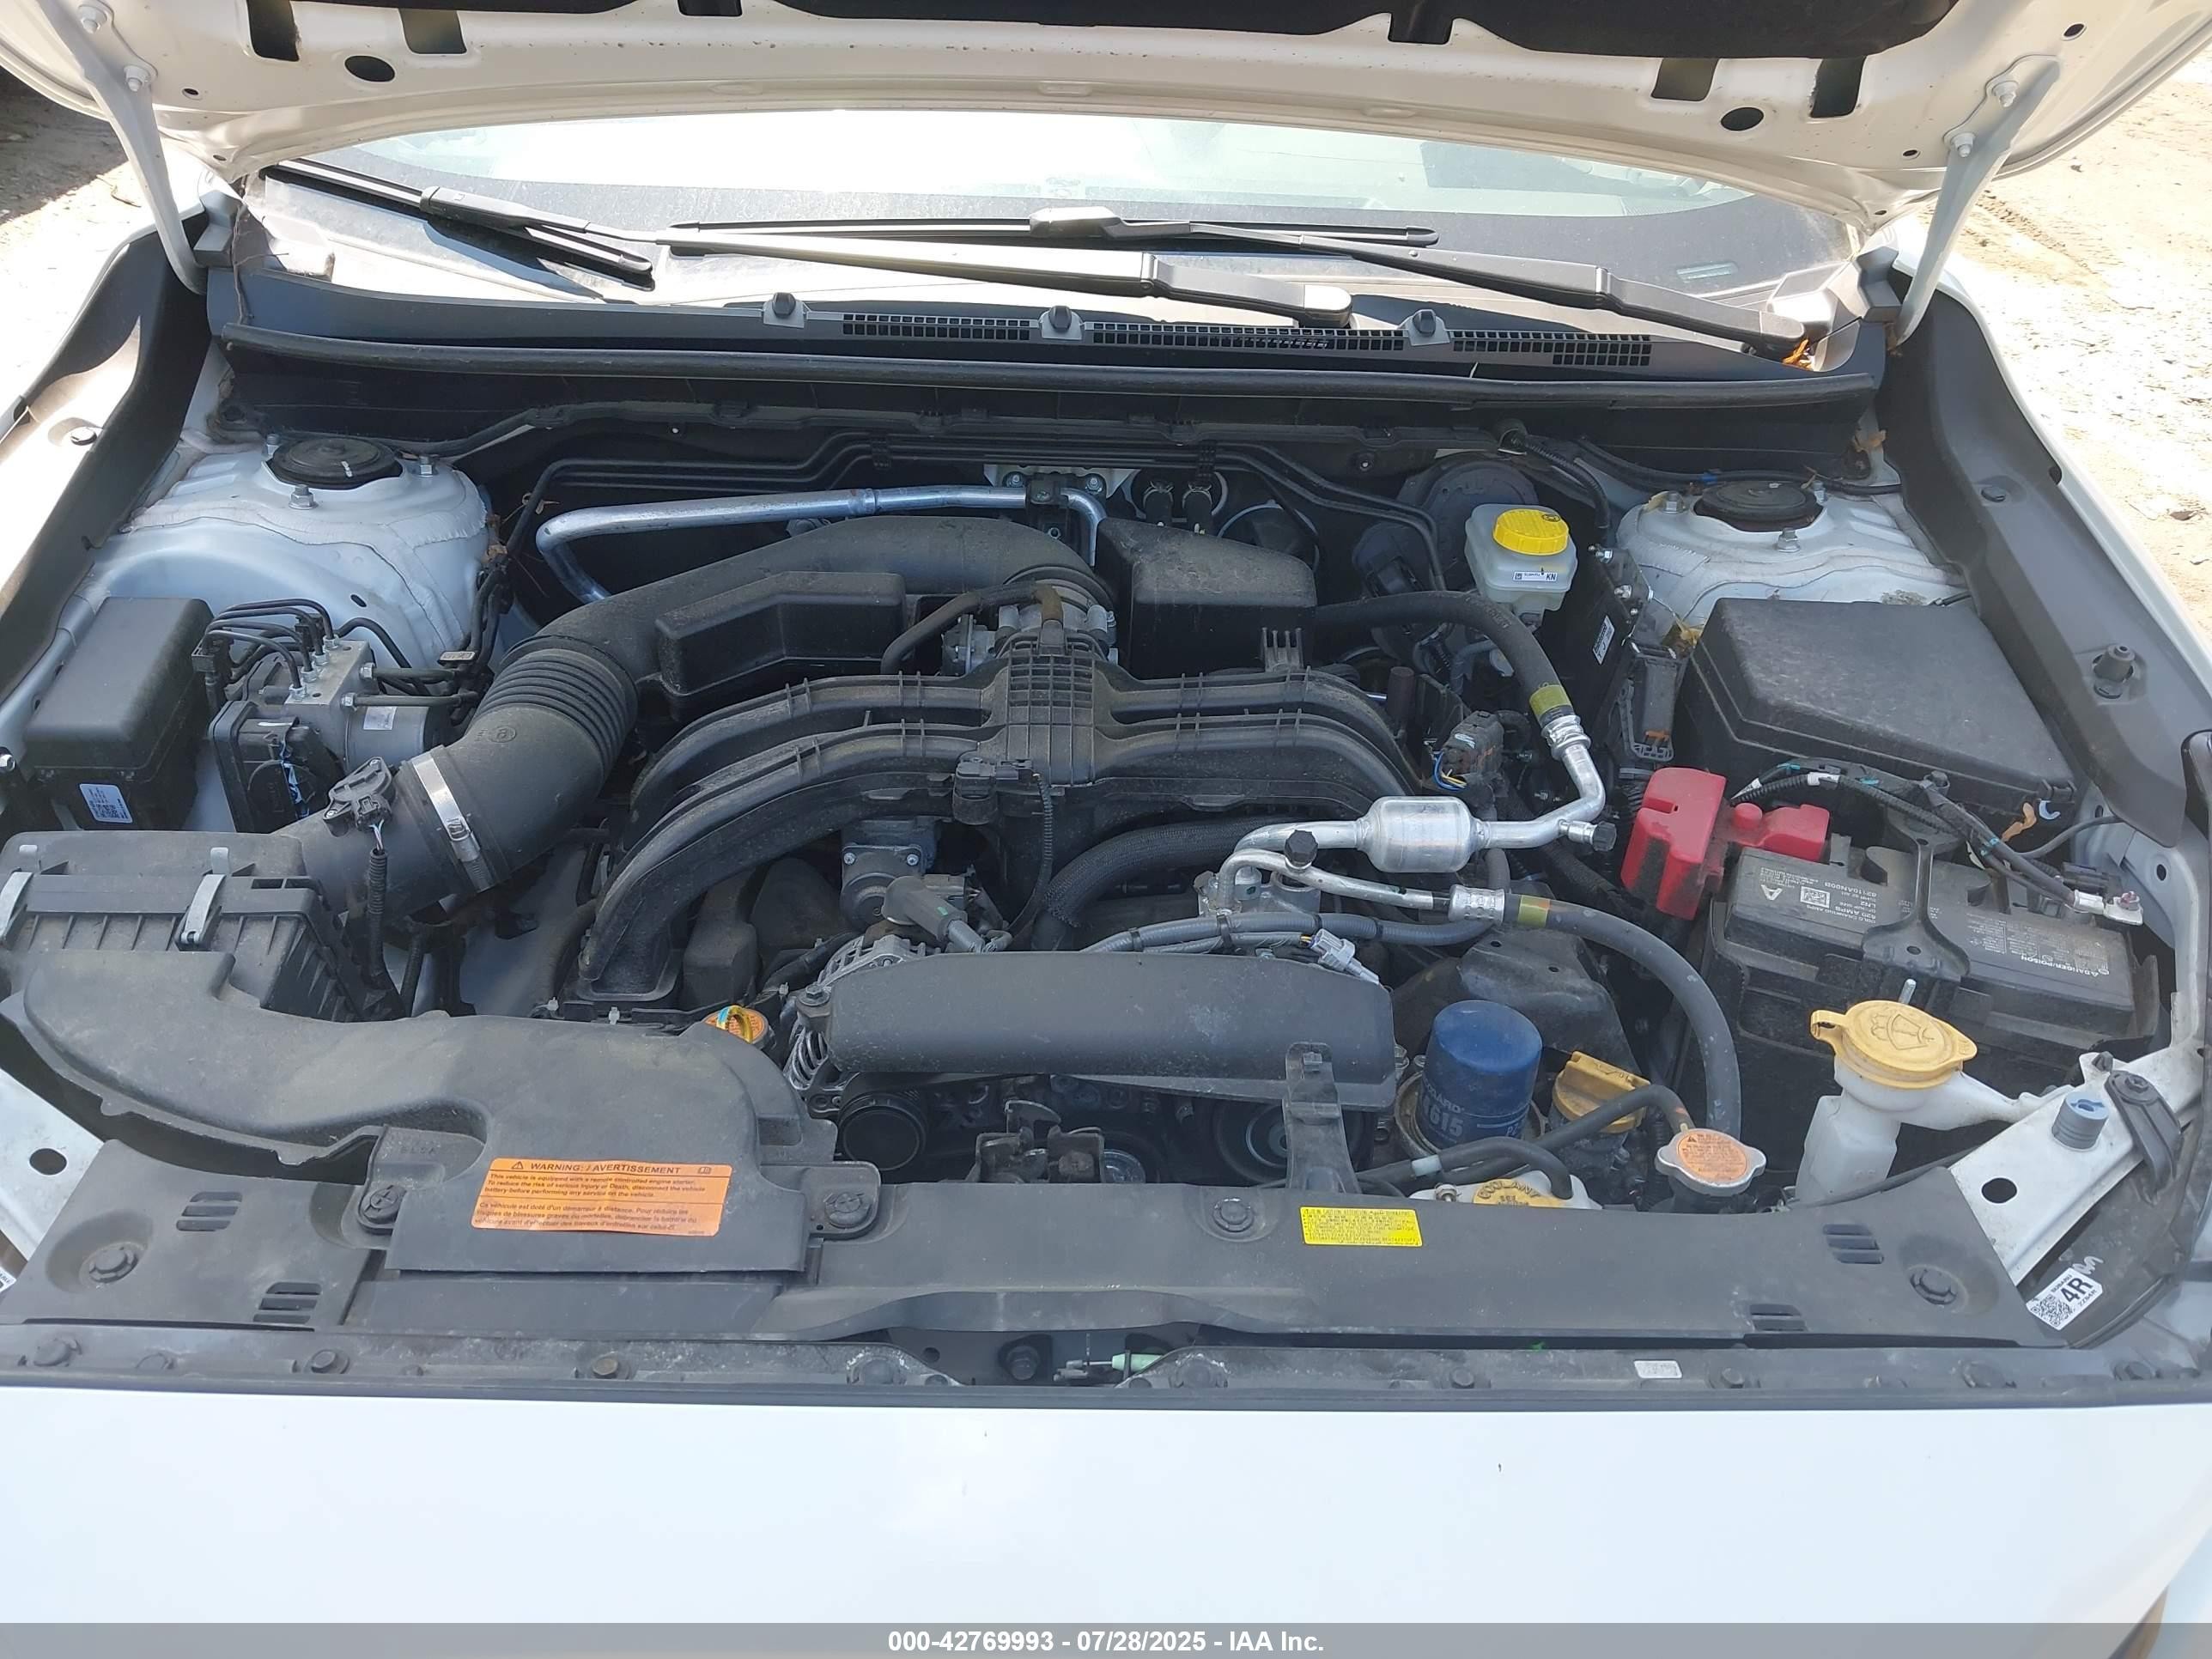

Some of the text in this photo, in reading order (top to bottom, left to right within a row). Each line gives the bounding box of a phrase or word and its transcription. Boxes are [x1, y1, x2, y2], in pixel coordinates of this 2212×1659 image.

[592, 1163, 681, 1175] AVERTISSEMENT
[1477, 1180, 1540, 1199] COOLANT
[2061, 1277, 2094, 1302] 4R
